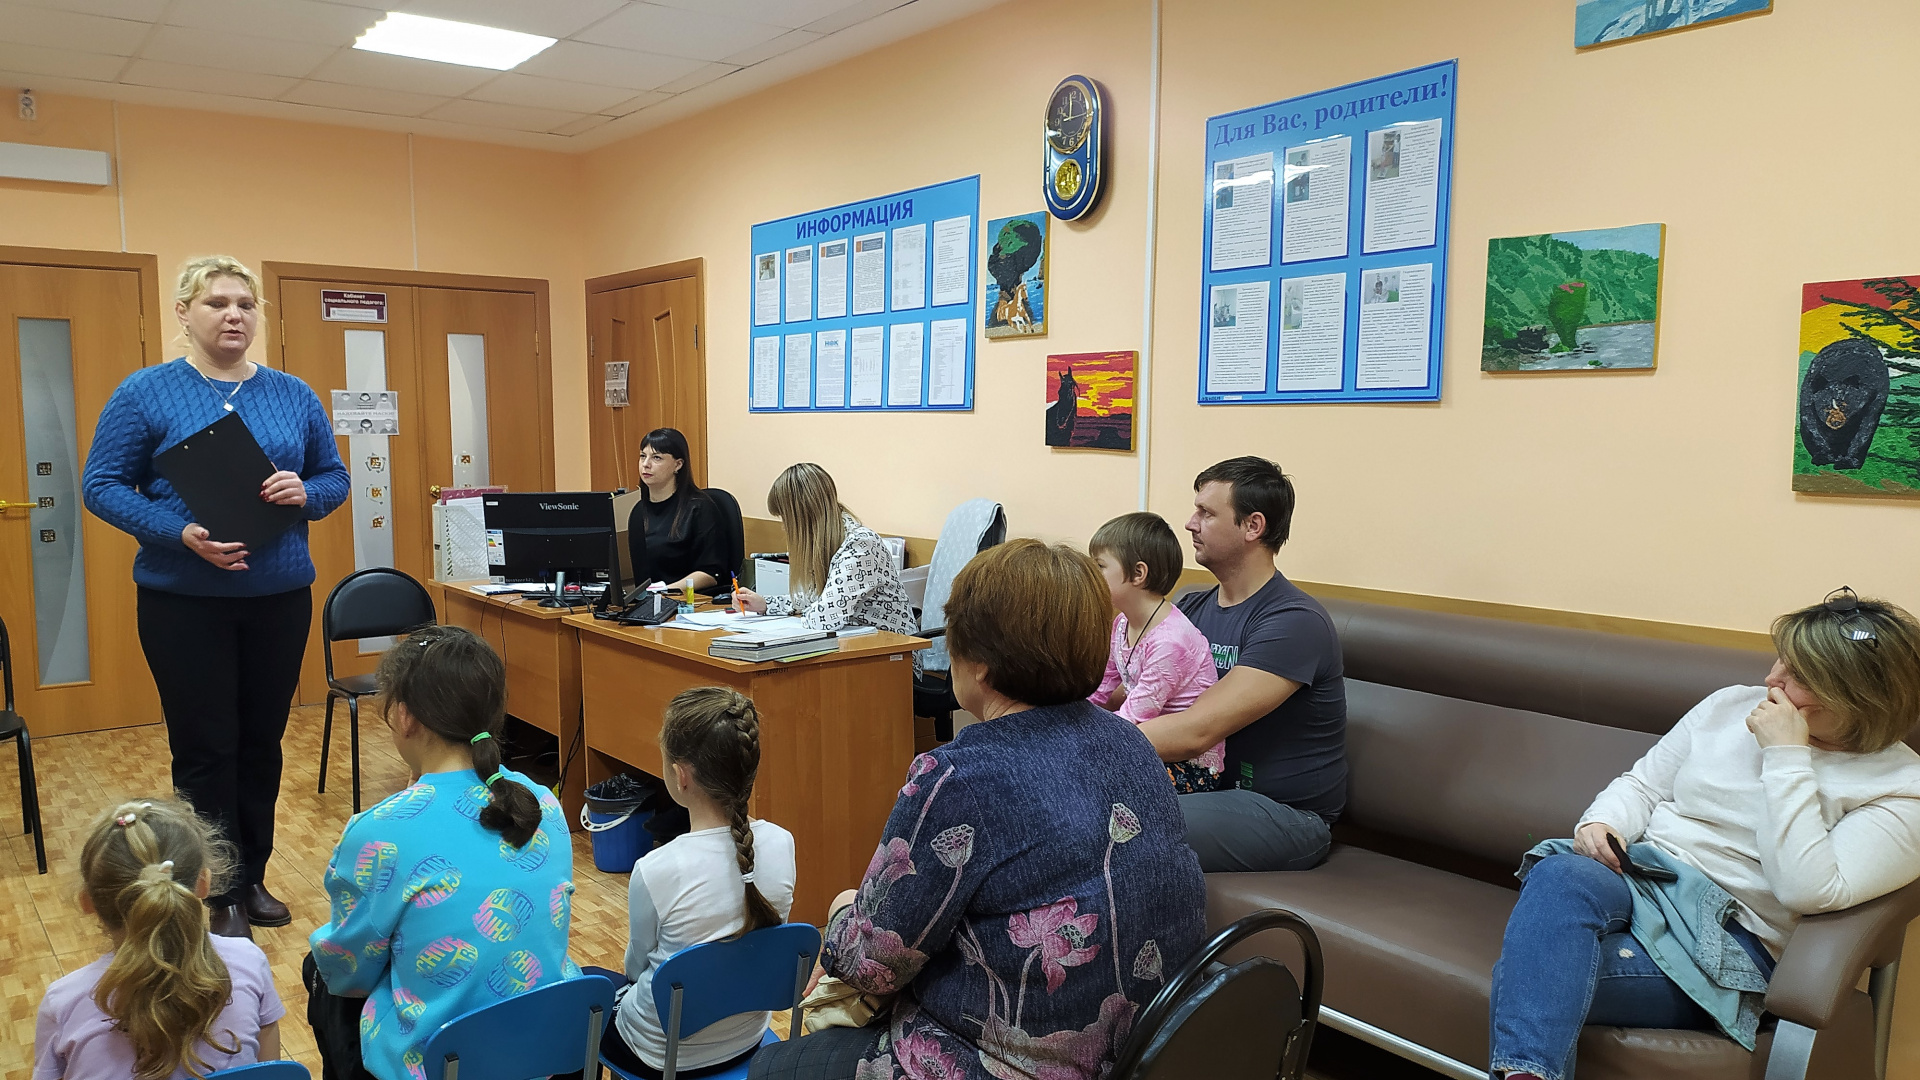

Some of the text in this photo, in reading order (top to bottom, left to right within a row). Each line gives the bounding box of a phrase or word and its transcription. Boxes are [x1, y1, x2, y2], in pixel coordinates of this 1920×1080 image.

[1213, 73, 1449, 149] Для Вас, родители!
[796, 198, 914, 240] ИНФОРМАЦИЯ
[539, 502, 580, 511] ViewSonic
